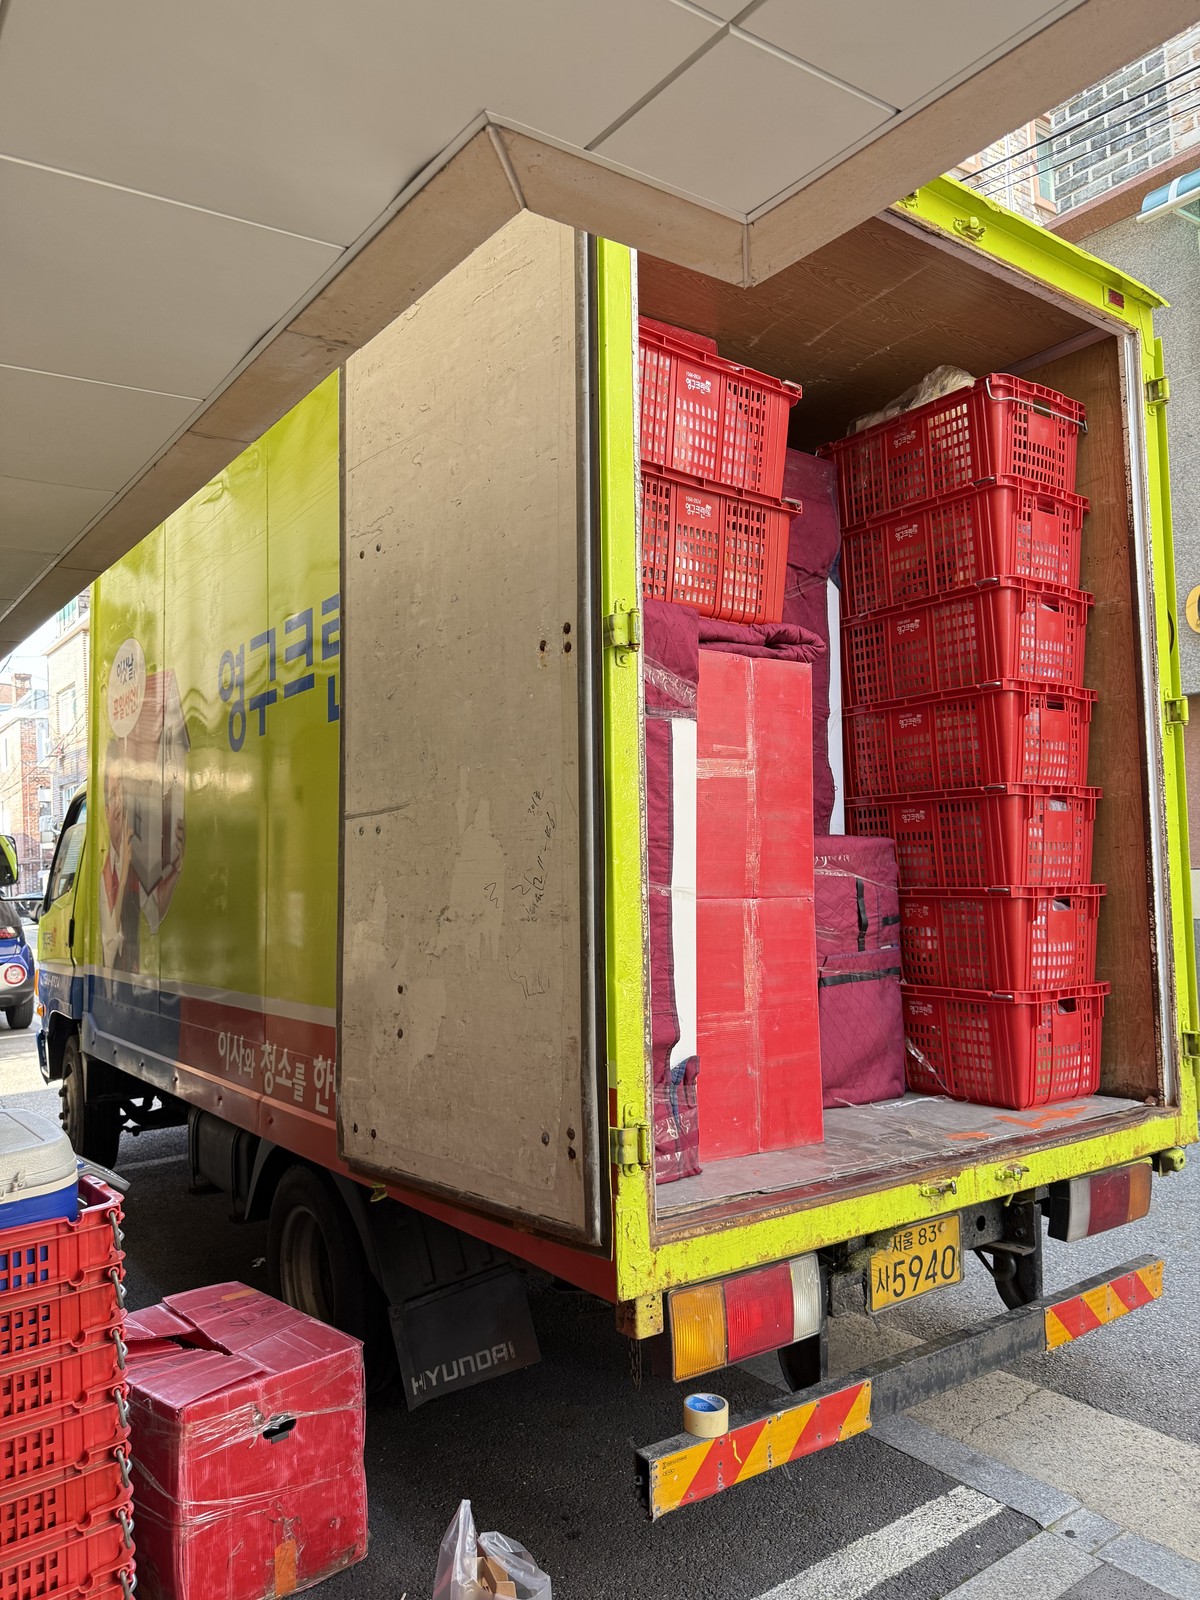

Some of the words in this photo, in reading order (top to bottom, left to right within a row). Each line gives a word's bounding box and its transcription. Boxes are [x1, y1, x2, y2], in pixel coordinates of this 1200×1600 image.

[217, 1031, 256, 1079] 이사와
[260, 1039, 307, 1102] 청소를
[313, 1053, 337, 1115] 한
[891, 1231, 914, 1253] 서울
[918, 1224, 938, 1246] 83
[410, 1341, 516, 1396] HYUNDAI
